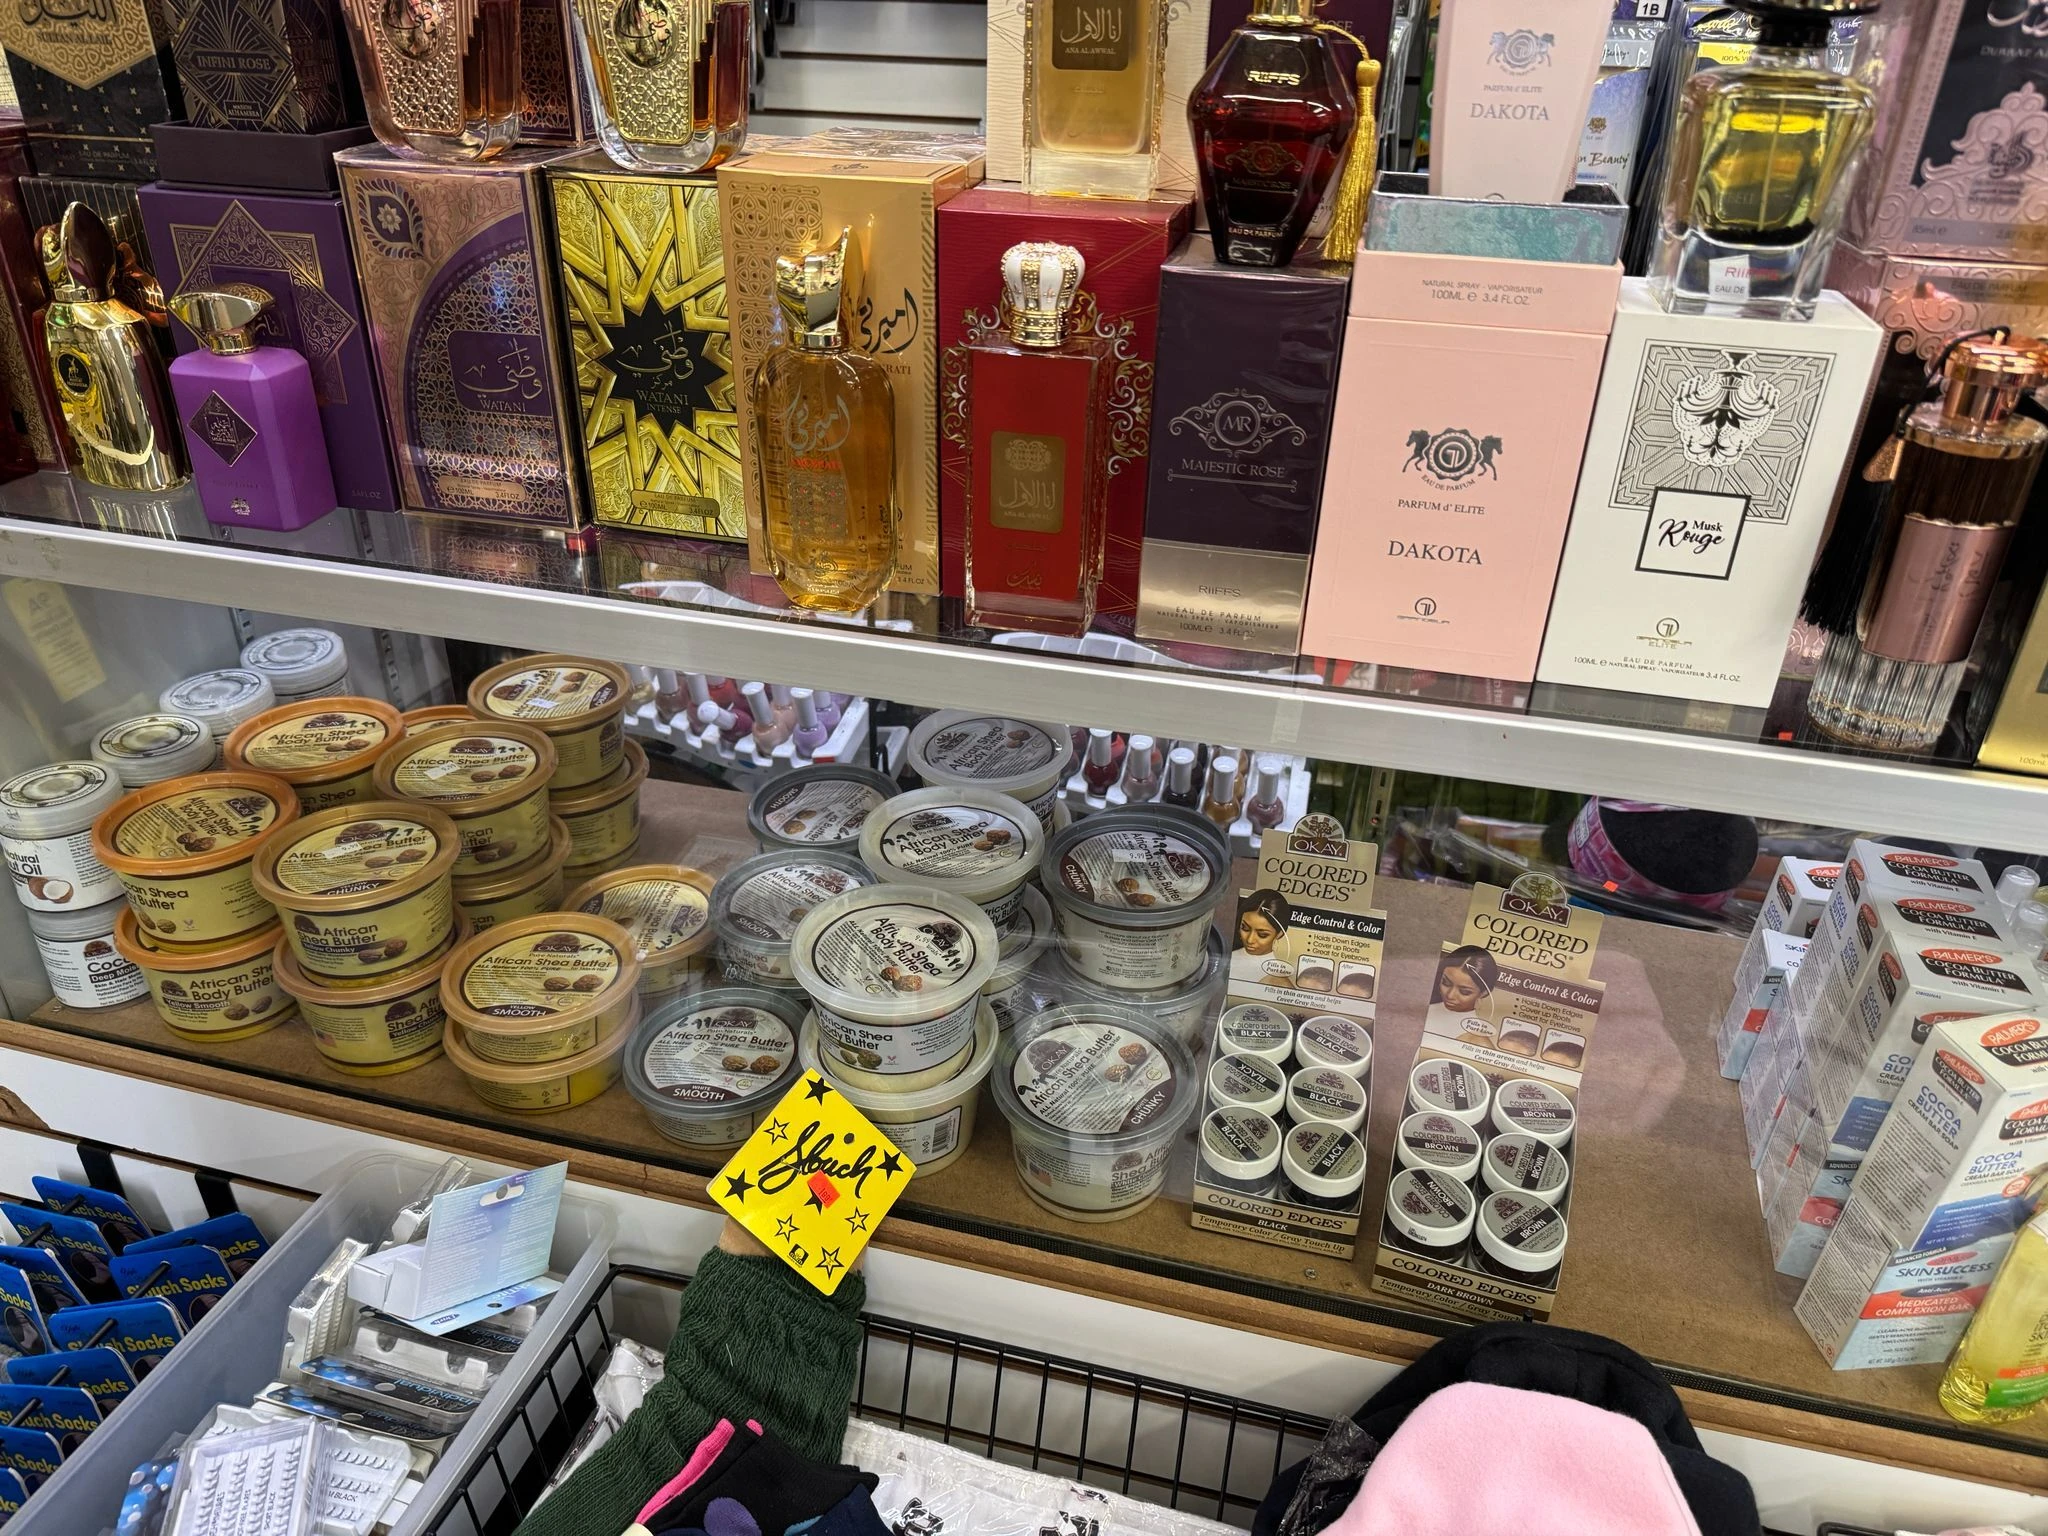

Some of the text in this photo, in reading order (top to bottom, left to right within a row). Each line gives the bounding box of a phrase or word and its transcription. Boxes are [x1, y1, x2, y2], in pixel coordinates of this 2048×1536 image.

[1642, 4, 1660, 16] 1B
[197, 55, 271, 71] INFINI ROSE
[1470, 103, 1549, 121] DAKOTA
[1588, 143, 1628, 169] Beauty
[1422, 279, 1543, 294] NATURAL SPRAY VAPORISATEUR
[479, 399, 526, 413] WATANI
[636, 389, 689, 406] WATANI
[646, 402, 681, 415] INTENSE
[1222, 415, 1252, 433] MR
[1182, 457, 1286, 479] MAJESTIC ROSE
[1398, 498, 1441, 512] PARFUM
[1454, 504, 1485, 515] ELITE
[1691, 519, 1723, 533] Musk
[1658, 518, 1725, 555] Rouge
[1387, 540, 1483, 565] DAKOTA
[1175, 606, 1261, 621] EAU DE PARFUM
[268, 727, 367, 742] African Shea
[277, 734, 353, 746] Body Butter
[453, 746, 491, 755] OKAY
[386, 834, 428, 848] Butter
[900, 820, 989, 854] African Shea
[914, 829, 985, 857] Body Butter
[1294, 839, 1343, 857] OKAY
[22, 863, 43, 876] Oil
[1893, 854, 1950, 867] PALMER'S
[1065, 864, 1089, 895] CHUNKY
[1264, 857, 1368, 886] COLORED
[1886, 861, 1970, 882] COCOA BUTTER
[1904, 869, 1958, 885] FORMULA
[150, 886, 189, 899] Shea
[327, 882, 380, 896] CHUNKY
[1276, 877, 1351, 902] EDGES
[1508, 898, 1563, 922] OKAY
[1906, 901, 1968, 913] PALMER'S
[1290, 911, 1382, 935] Edge Control & Color
[1899, 907, 1988, 929] COCOA BUTTER
[1918, 916, 1975, 932] FORMULA
[297, 931, 377, 946] Shea Butter
[323, 924, 379, 937] African
[1473, 913, 1589, 955] COLORED
[537, 944, 573, 953] OKAY
[1312, 940, 1333, 950] Cover
[1342, 945, 1360, 955] Roots
[1313, 934, 1370, 949] Holds Down Edges
[483, 955, 612, 969] African Shea Butter
[1312, 948, 1328, 956] Great
[1340, 951, 1370, 963] Eyebrows
[1484, 936, 1568, 970] EDGES
[1931, 949, 1996, 964] PALMER'S
[90, 973, 116, 983] Deep
[1925, 958, 2016, 982] COCOA BUTTER
[1944, 967, 2002, 985] FORMULA
[189, 971, 250, 991] African
[193, 976, 275, 1003] Body Butter
[1497, 971, 1598, 1007] Edge Control & Color
[193, 999, 231, 1010] Smooth
[491, 1008, 547, 1018] SMOOTH
[388, 1015, 423, 1032] Shea
[819, 1010, 893, 1042] African Shea
[663, 1030, 789, 1050] African Shea Butter
[1240, 1029, 1272, 1038] BLACK
[1988, 1021, 2034, 1045] PALMER'S
[1315, 1035, 1347, 1056] BLACK
[1991, 1040, 2027, 1056] COCOA
[1238, 1063, 1267, 1085] BLACK
[672, 1088, 725, 1101] SMOOTH
[1457, 1074, 1468, 1099] BROWN
[1130, 1090, 1167, 1126] CHUNKY
[1309, 1092, 1343, 1108] BLACK
[1920, 1085, 1962, 1130] COCOA
[1522, 1110, 1556, 1119] BROWN
[1916, 1095, 1958, 1138] BUTTER
[1221, 1124, 1248, 1151] BLACK
[1413, 1131, 1468, 1144] COLORED EDGES
[1321, 1143, 1346, 1168] BLACK
[1424, 1142, 1459, 1152] BROWN
[1974, 1150, 2023, 1165] COCOA
[1530, 1154, 1546, 1180] BROWN
[1968, 1160, 2017, 1174] BUTTER
[1426, 1181, 1455, 1207] BROWN
[95, 1206, 137, 1225] Socks
[1207, 1193, 1342, 1231] COLORED EDGES
[1257, 1218, 1289, 1231] BLACK
[1519, 1218, 1549, 1240] BROWN
[1199, 1215, 1346, 1253] Temporary Color Gray Touch Up
[63, 1236, 107, 1256] Socks
[182, 1274, 228, 1294] Socks
[1391, 1257, 1537, 1305] COLORED EDGES
[1380, 1278, 1433, 1298] Temporary
[1432, 1293, 1460, 1307] Color
[1466, 1301, 1490, 1315] Gray
[1426, 1282, 1495, 1307] DARK BROWN
[1895, 1297, 1959, 1308] MEDICATED
[1875, 1303, 1970, 1317] COMPLEXION BAR
[121, 1333, 177, 1353] Socks
[51, 1413, 98, 1430] Socks
